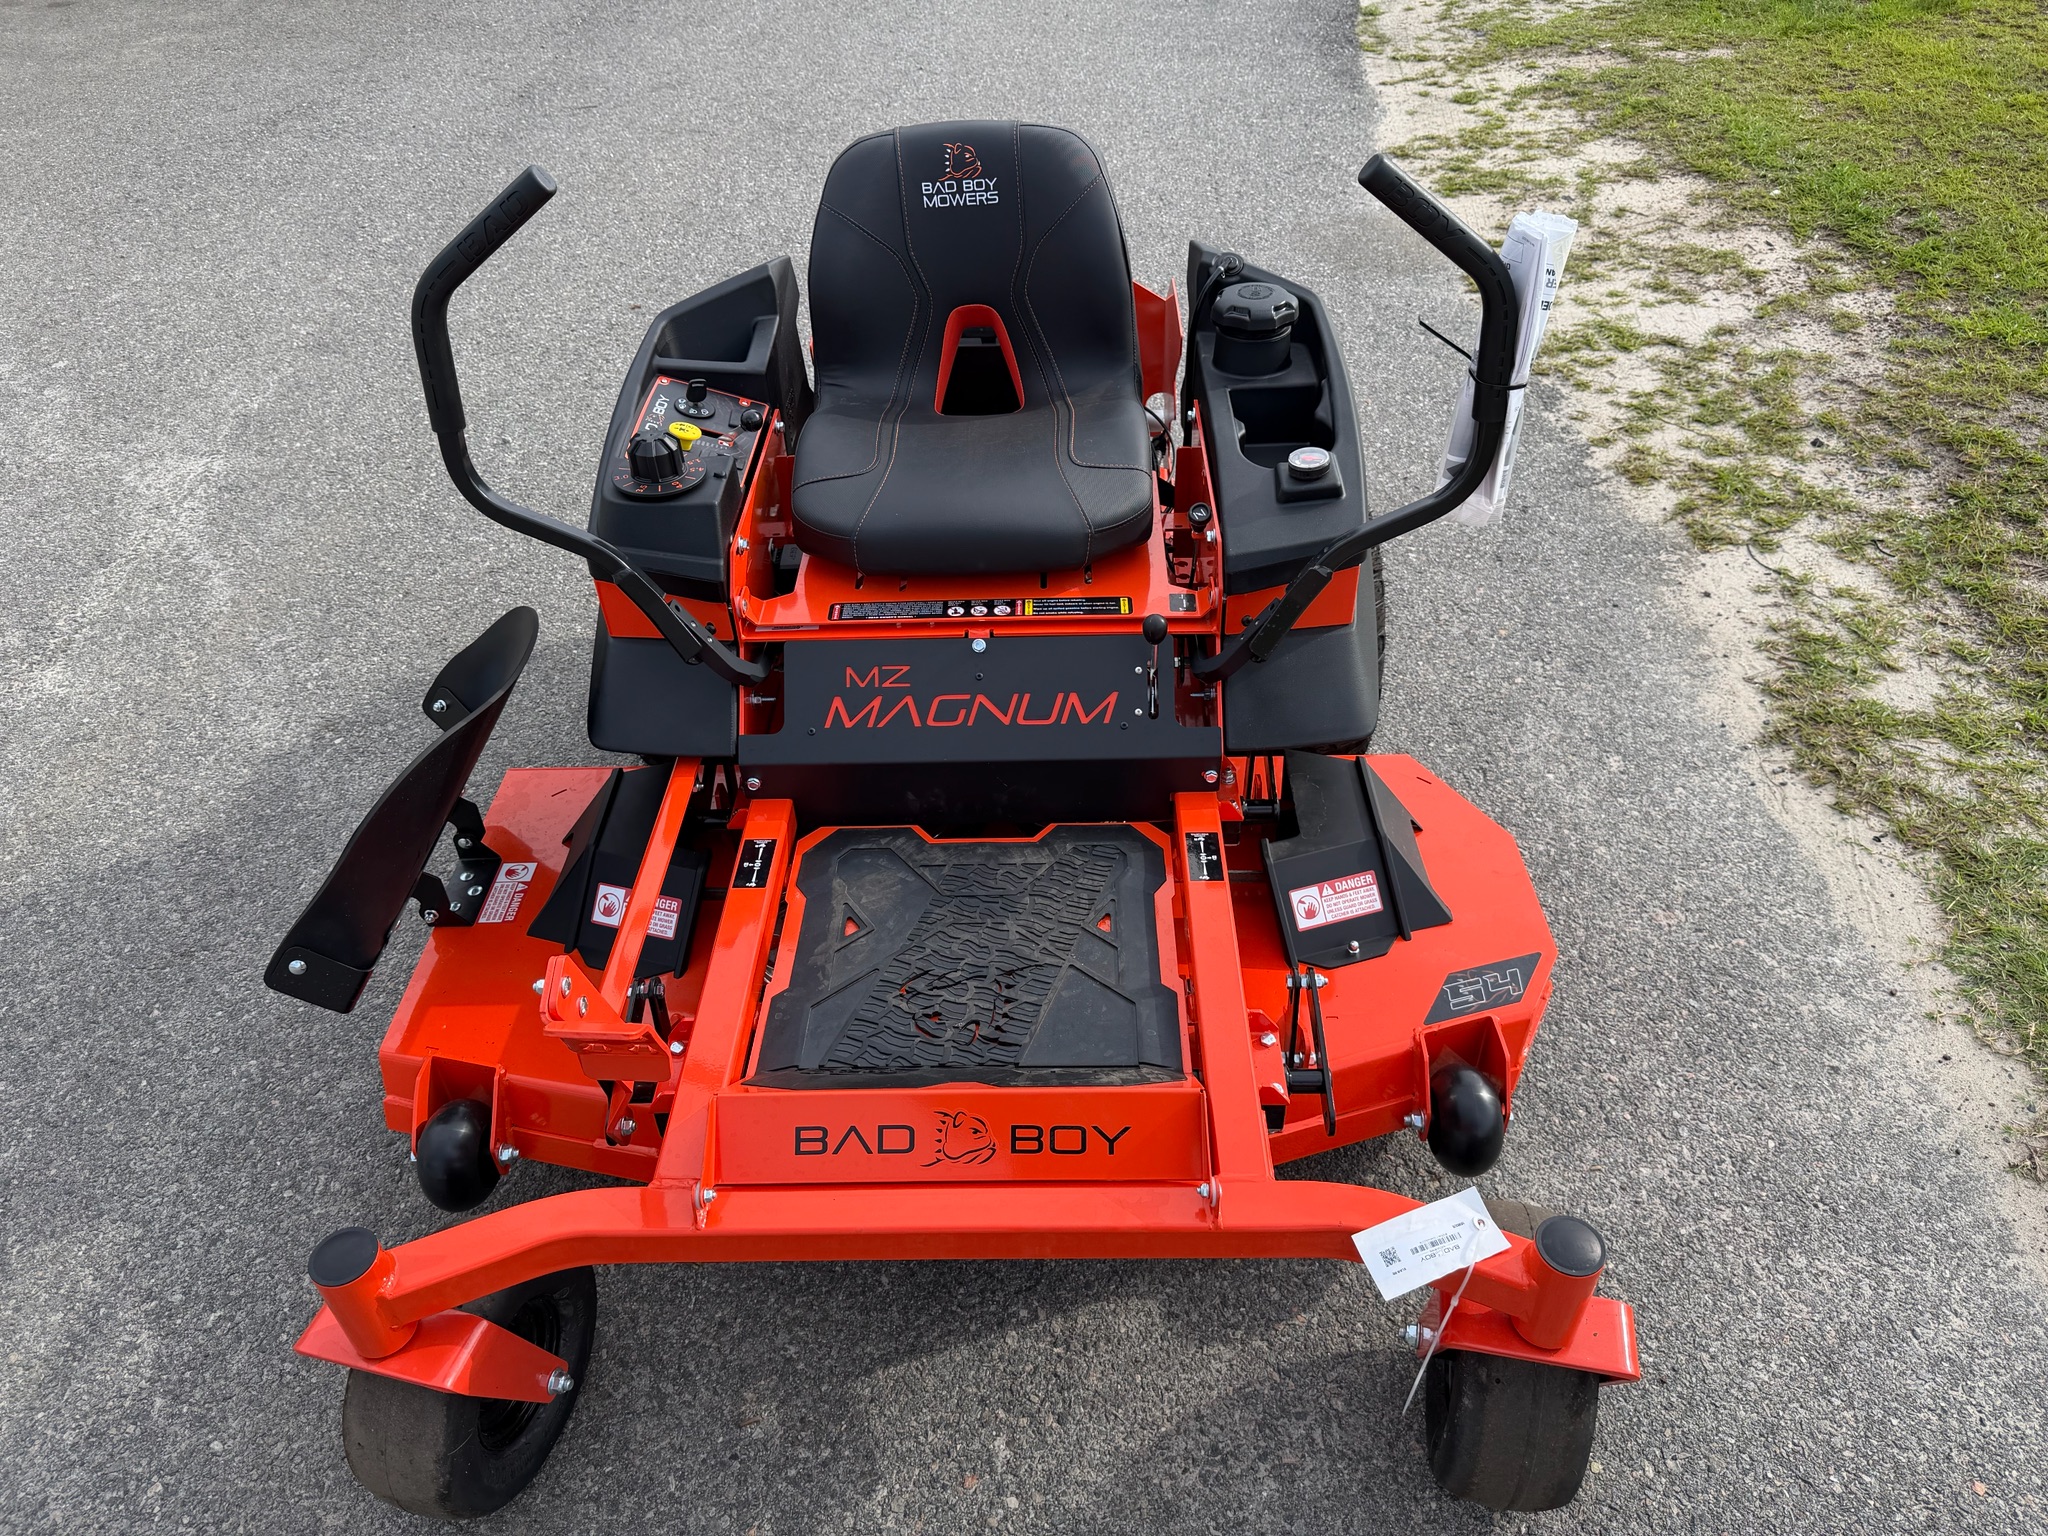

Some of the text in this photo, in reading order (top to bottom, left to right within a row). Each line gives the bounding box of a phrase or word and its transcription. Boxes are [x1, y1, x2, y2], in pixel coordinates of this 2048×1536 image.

[921, 177, 997, 194] BAD BOY
[923, 191, 999, 208] MOWERS
[1379, 176, 1466, 241] BOY
[457, 190, 528, 263] BAD
[652, 394, 670, 415] BOY
[845, 665, 911, 688] MZ
[824, 691, 1119, 729] MAGNUM
[1335, 874, 1373, 892] DANGER
[504, 892, 524, 921] DANGER
[1443, 968, 1523, 1010] 54
[794, 1124, 1132, 1156] BAD BOY
